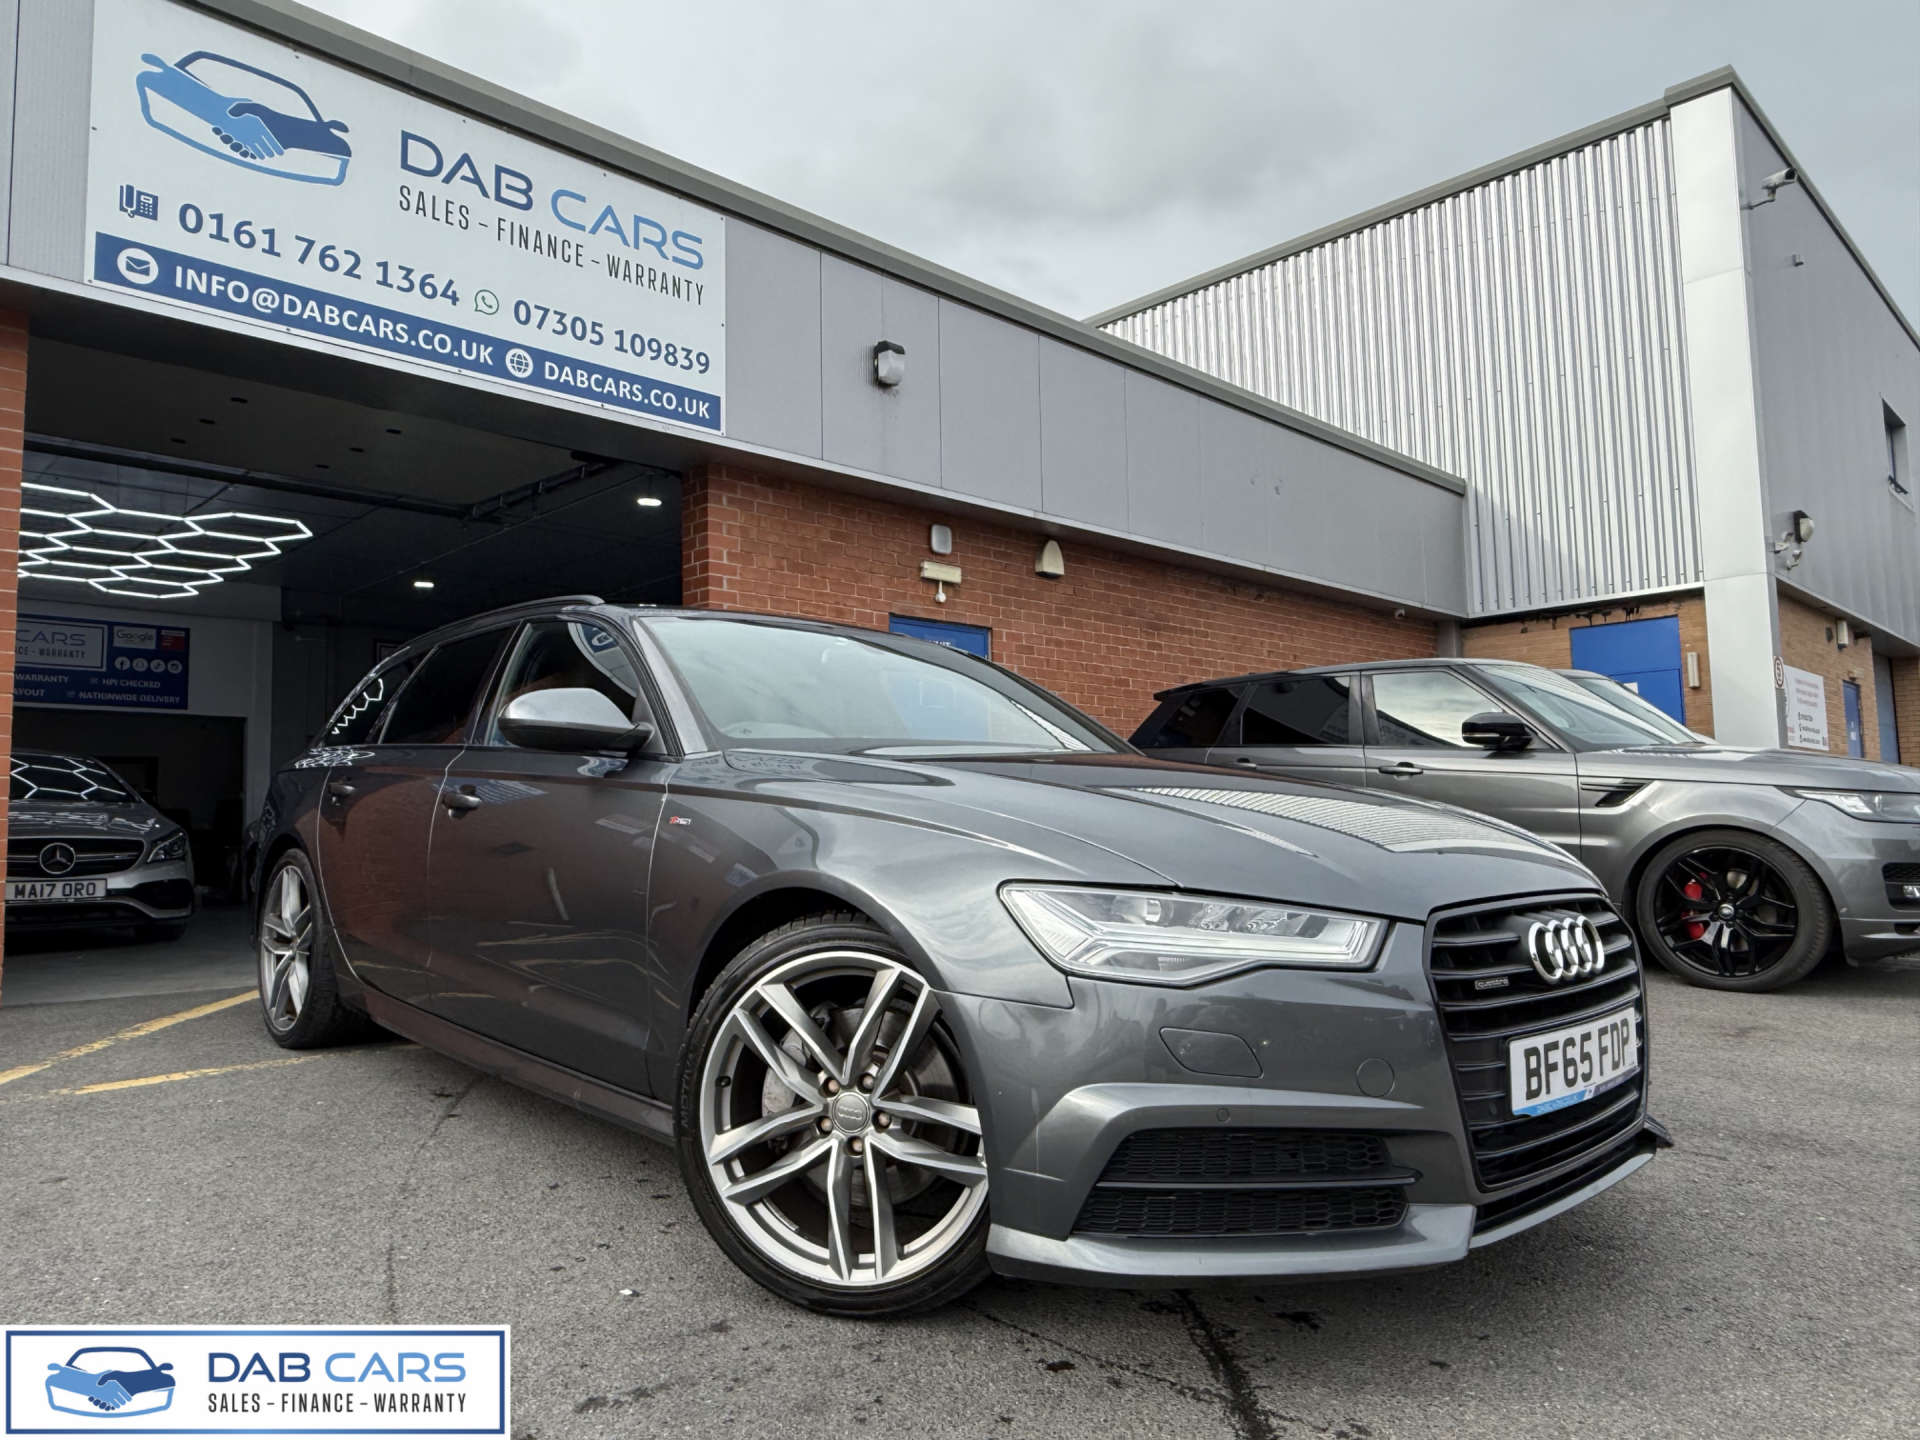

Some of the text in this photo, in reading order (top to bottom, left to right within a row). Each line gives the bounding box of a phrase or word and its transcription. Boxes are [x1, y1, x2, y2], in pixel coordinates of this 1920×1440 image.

[400, 130, 704, 270] DAB CARS
[179, 203, 460, 306] 0161 762 1364
[399, 185, 470, 230] SALES
[497, 217, 584, 268] FINANCE
[607, 254, 704, 305] WARRANTY
[174, 265, 494, 366] INFO@DABCARS.CO.UK
[513, 300, 711, 374] 07305 109839
[544, 361, 711, 419] DABCARS.CO.UK
[16, 630, 86, 646] CARS
[13, 688, 45, 697] AYOUT
[15, 673, 69, 683] WARRANTY
[79, 691, 181, 704] NATIONWIDE DELIVERY
[120, 679, 161, 689] CHECKED
[14, 882, 96, 898] MA17 ORO
[1523, 1017, 1630, 1101] BF65 FDP
